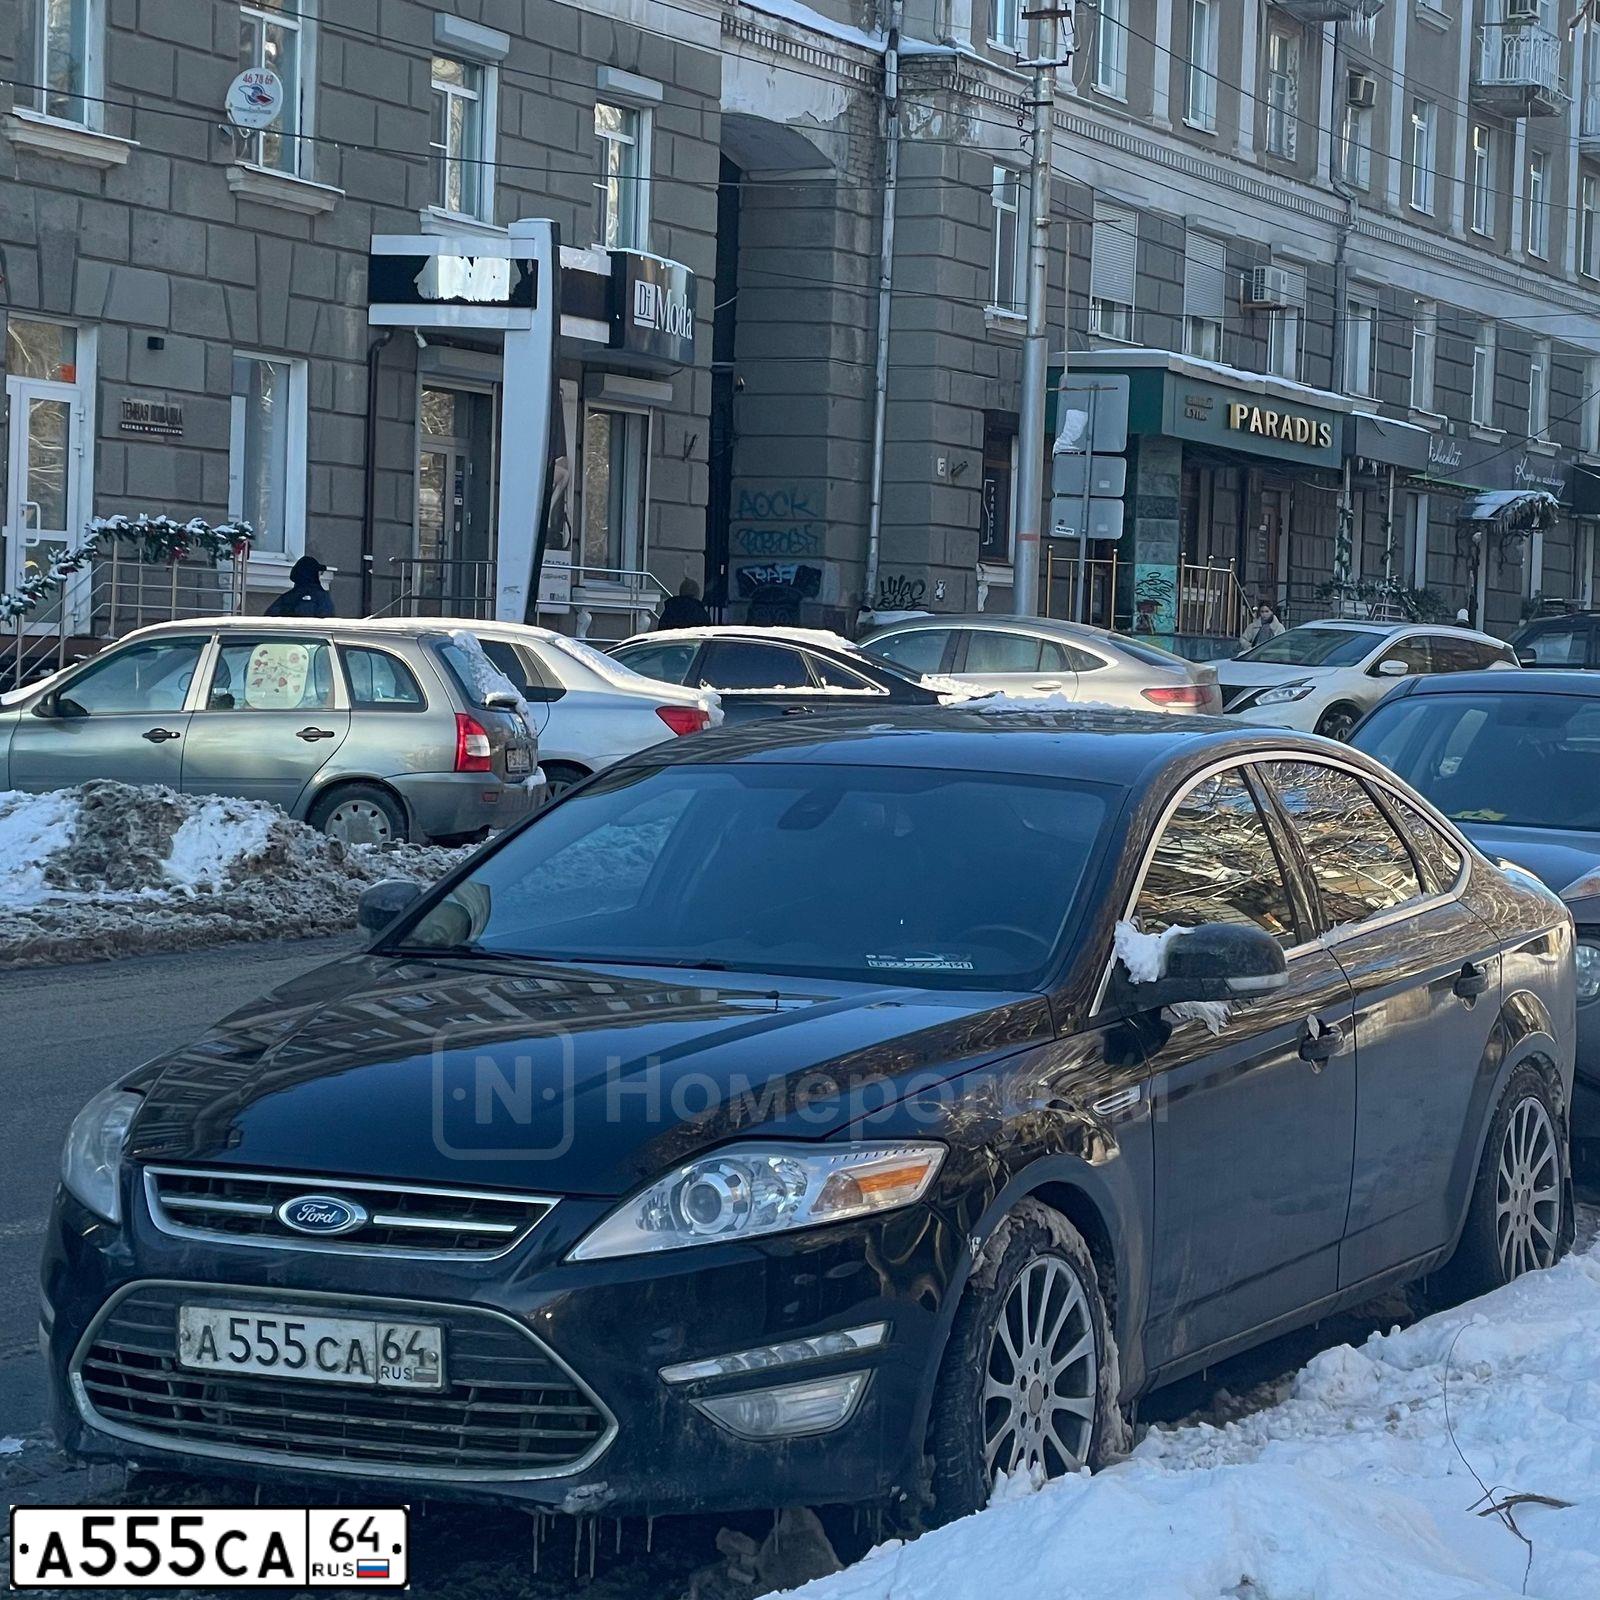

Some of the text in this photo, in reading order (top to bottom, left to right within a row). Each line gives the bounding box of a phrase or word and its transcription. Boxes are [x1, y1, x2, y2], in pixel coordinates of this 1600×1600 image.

[655, 285, 692, 340] Moda
[1229, 402, 1333, 449] PARADIS
[296, 1203, 338, 1225] Ford
[381, 1328, 425, 1367] 64
[380, 1365, 412, 1381] RUS
